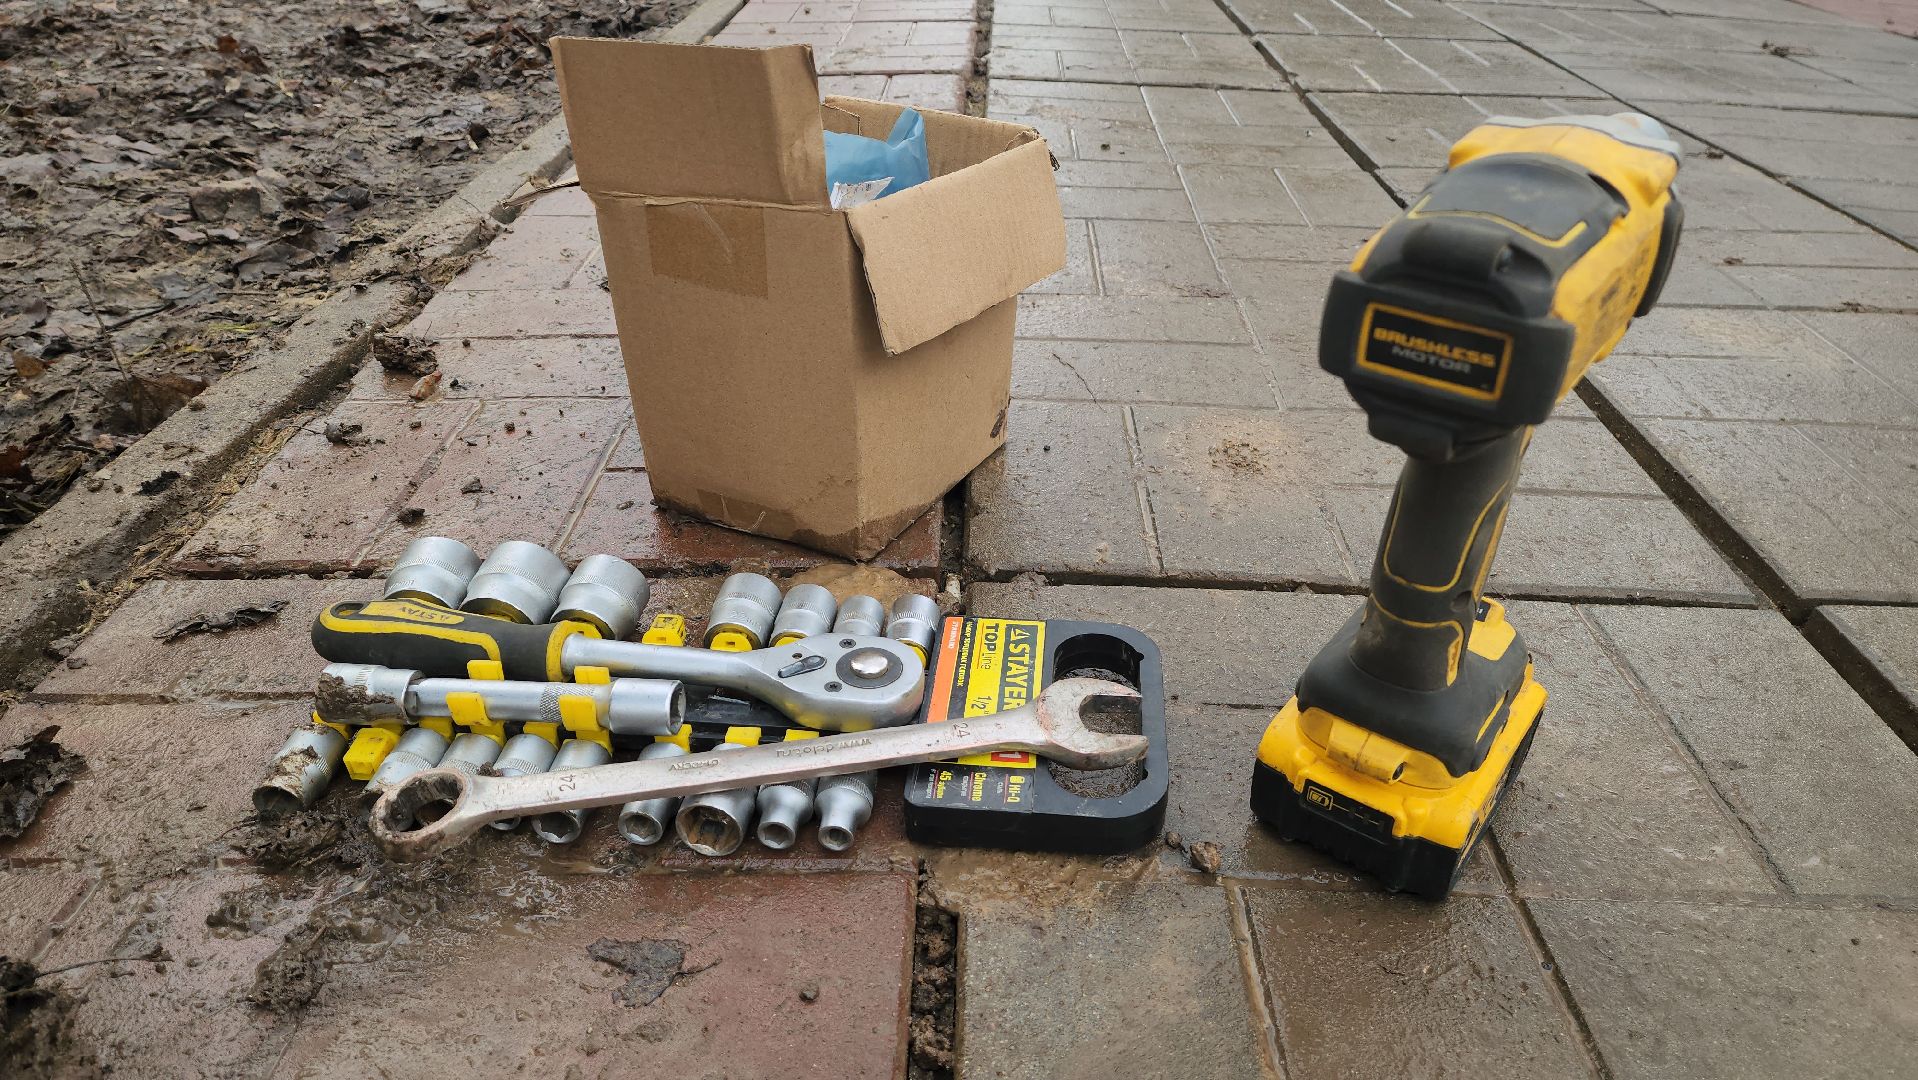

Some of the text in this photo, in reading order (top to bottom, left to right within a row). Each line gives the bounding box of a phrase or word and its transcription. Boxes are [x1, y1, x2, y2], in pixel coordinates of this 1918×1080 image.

[1373, 327, 1496, 368] BRUSHLESS
[1391, 345, 1472, 374] MOTOR
[1002, 642, 1030, 711] STAYER
[952, 722, 971, 738] 24
[559, 774, 577, 792] 24
[939, 770, 952, 781] 45
[971, 772, 987, 802] Chrome
